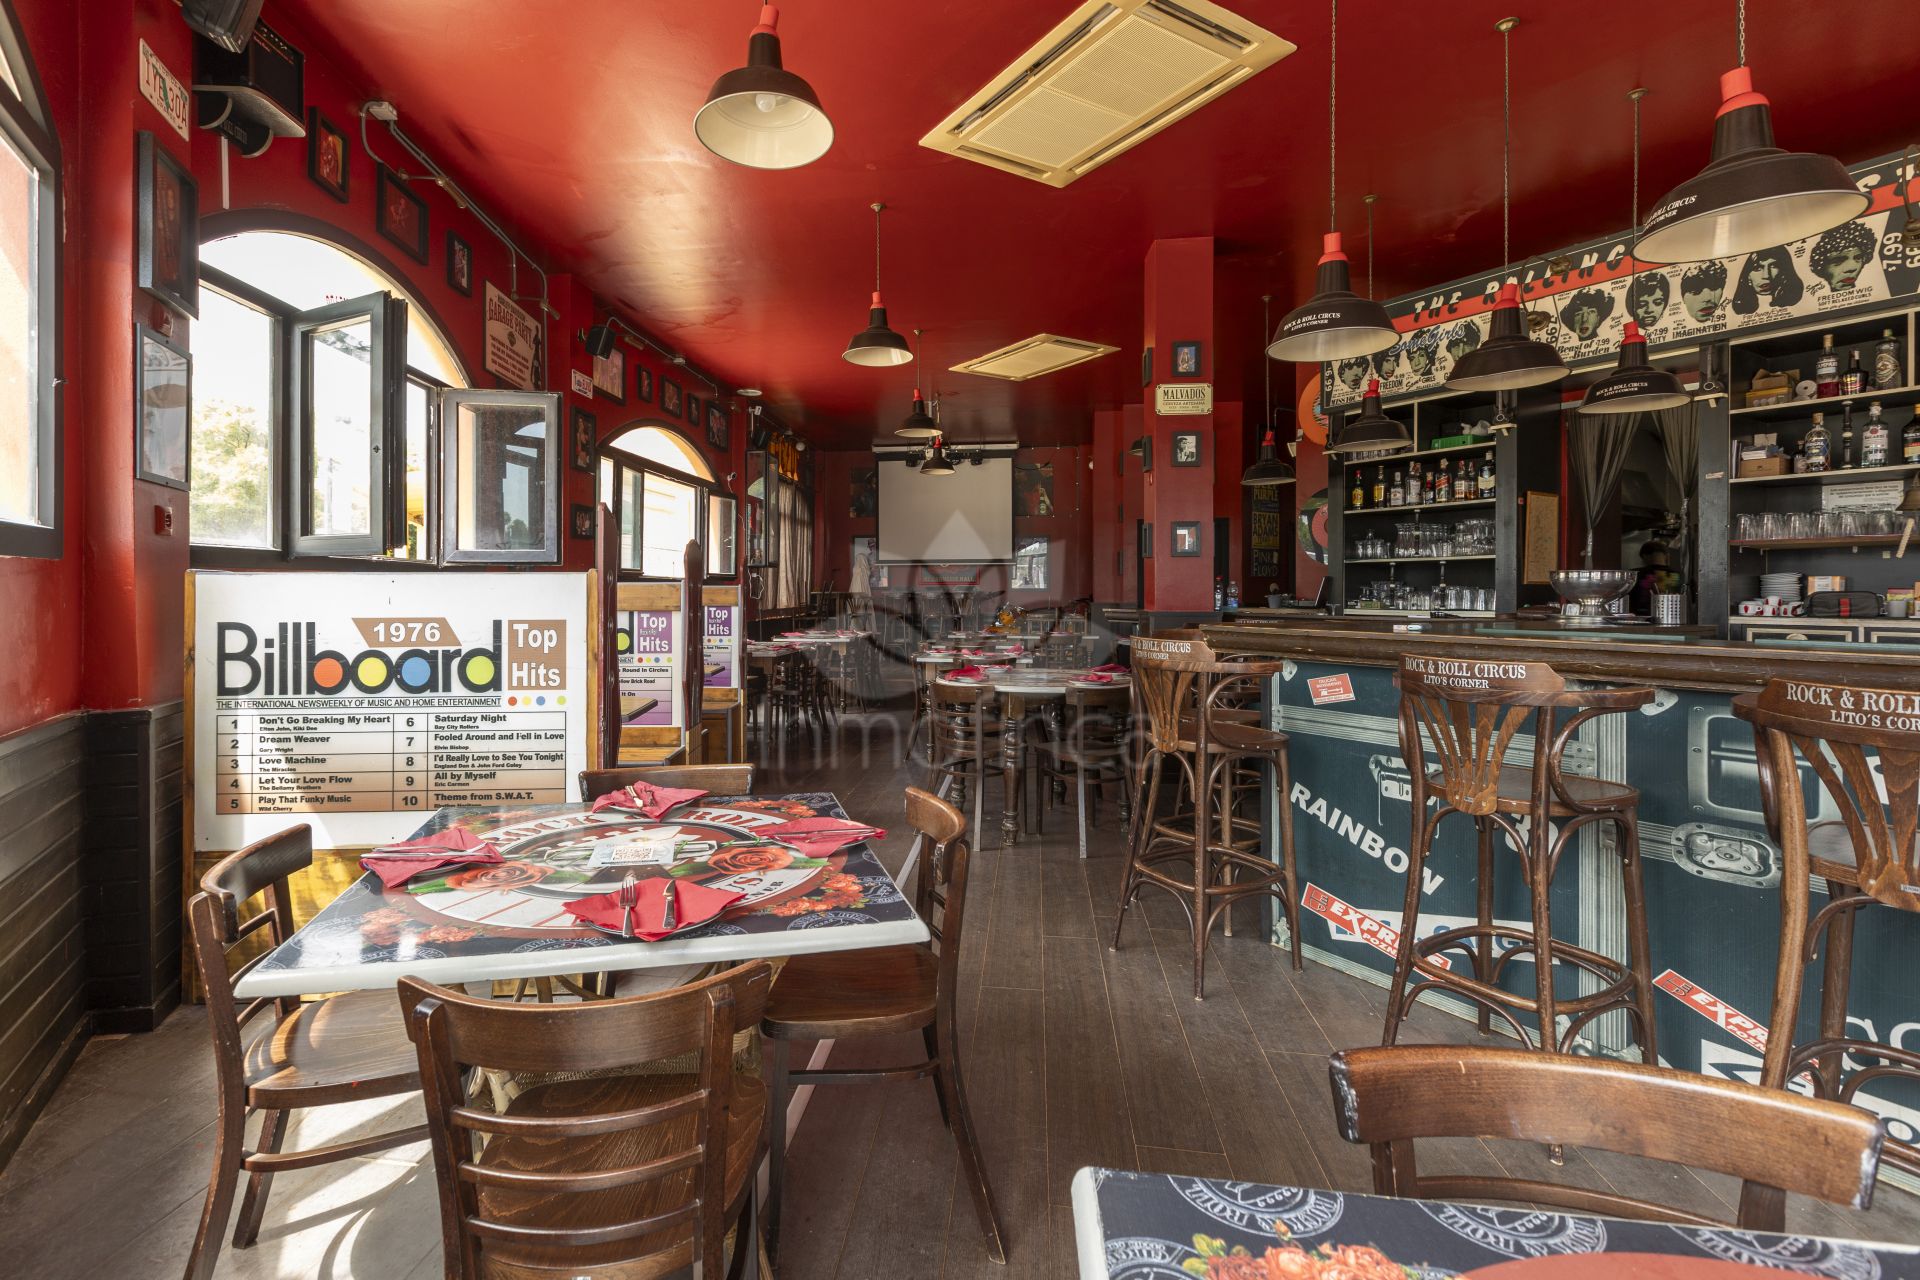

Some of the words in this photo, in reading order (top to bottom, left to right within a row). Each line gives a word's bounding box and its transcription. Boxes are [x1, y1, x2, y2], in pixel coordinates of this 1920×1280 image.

[1667, 195, 1698, 211] CIRCUS
[1817, 291, 1854, 302] FREEDOM
[1855, 286, 1873, 295] WIG
[488, 298, 514, 329] GARAGE
[1414, 291, 1462, 323] THE
[1302, 314, 1317, 323] ROLL
[1317, 312, 1341, 320] CIRCUS
[1306, 319, 1329, 327] CORNER
[1672, 322, 1728, 339] IMAGINATION
[1427, 324, 1466, 352] Girls
[1558, 342, 1583, 353] Beast
[1583, 340, 1594, 350] of
[1573, 347, 1610, 359] Burden
[1380, 379, 1403, 391] FREEDOM
[1163, 389, 1206, 400] MALVADOS
[1252, 513, 1279, 525] BRYAN
[1252, 525, 1279, 537] ADAMS
[709, 607, 728, 620] Top
[641, 613, 667, 631] Top
[373, 622, 441, 643] 1976
[708, 624, 730, 635] Hits
[512, 623, 558, 654] Top
[639, 637, 669, 652] Hits
[1160, 641, 1192, 653] CIRCUS
[216, 620, 502, 696] Billboard
[1147, 651, 1169, 660] CORNER
[511, 662, 561, 687] Hits
[1405, 656, 1425, 673] ROCK
[1427, 660, 1435, 674] &
[1438, 661, 1471, 677] ROLL
[1474, 663, 1526, 679] CIRCUS
[1449, 677, 1490, 689] CORNER
[1786, 682, 1834, 706] ROCK
[1840, 689, 1855, 709] &
[216, 701, 233, 709] THE
[234, 700, 296, 708] INTERNATIONAL
[298, 699, 353, 708] NEWSWEEKLY
[355, 699, 366, 707] OF
[367, 699, 392, 707] MUSIC
[413, 698, 437, 706] HOME
[438, 697, 501, 706] ENTERTAINMENT
[231, 719, 238, 729] 1
[259, 716, 284, 725] Don't
[286, 716, 300, 724] Go
[302, 716, 346, 726] Breaking
[348, 715, 362, 725] My
[364, 715, 391, 724] Heart
[406, 717, 414, 727] 6
[434, 715, 478, 723] Saturday
[480, 714, 507, 723] Night
[1886, 715, 1920, 731] COR
[231, 739, 239, 749] 2
[259, 735, 292, 743] Dream
[294, 735, 331, 743] Weaver
[406, 737, 414, 747] 7
[434, 733, 463, 741] Fooled
[465, 733, 496, 741] Around
[498, 732, 514, 740] and
[534, 732, 542, 740] in
[544, 732, 565, 740] Love
[230, 759, 239, 769] 3
[259, 757, 282, 765] Love
[285, 756, 327, 764] Machine
[406, 756, 414, 766] 8
[446, 753, 470, 762] Really
[501, 753, 517, 761] See
[518, 753, 533, 761] You
[534, 752, 564, 762] Tonight
[230, 779, 239, 789] 4
[259, 776, 275, 784] Let
[278, 776, 300, 784] Your
[303, 776, 326, 784] Love
[329, 775, 353, 784] Flow
[406, 776, 414, 786] 9
[434, 772, 448, 780] All
[450, 772, 461, 781] by
[464, 771, 497, 780] Myself
[230, 799, 239, 809] 5
[258, 796, 277, 805] Play
[279, 795, 298, 803] That
[300, 795, 325, 804] Funky
[327, 795, 352, 803] Music
[401, 796, 418, 806] 10
[434, 793, 468, 801] Theme
[470, 792, 493, 801] from
[495, 792, 534, 800] S.W.A.T.
[1289, 781, 1445, 896] RAINBOW
[1184, 1183, 1250, 1226] ROLL
